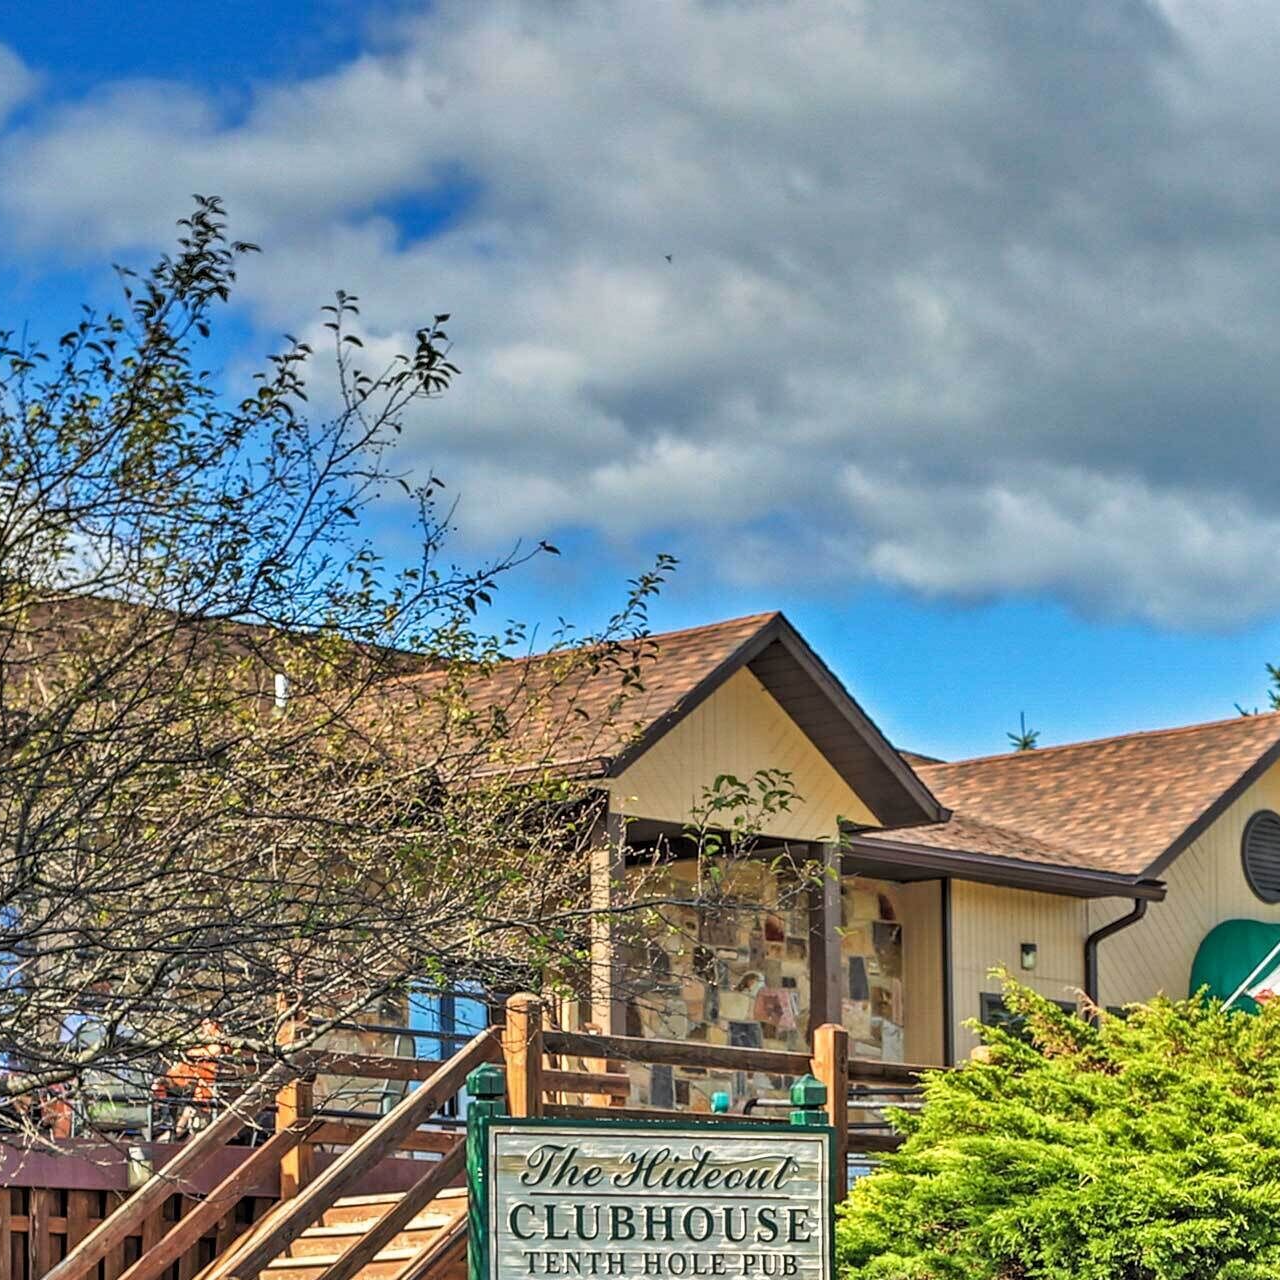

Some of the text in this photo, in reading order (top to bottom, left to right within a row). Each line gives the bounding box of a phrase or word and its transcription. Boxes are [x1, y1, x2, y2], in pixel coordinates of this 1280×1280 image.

[519, 1143, 801, 1191] The Hideout
[508, 1203, 813, 1244] CLUBHOUSE
[522, 1250, 799, 1277] TENTH HOLE PUB
